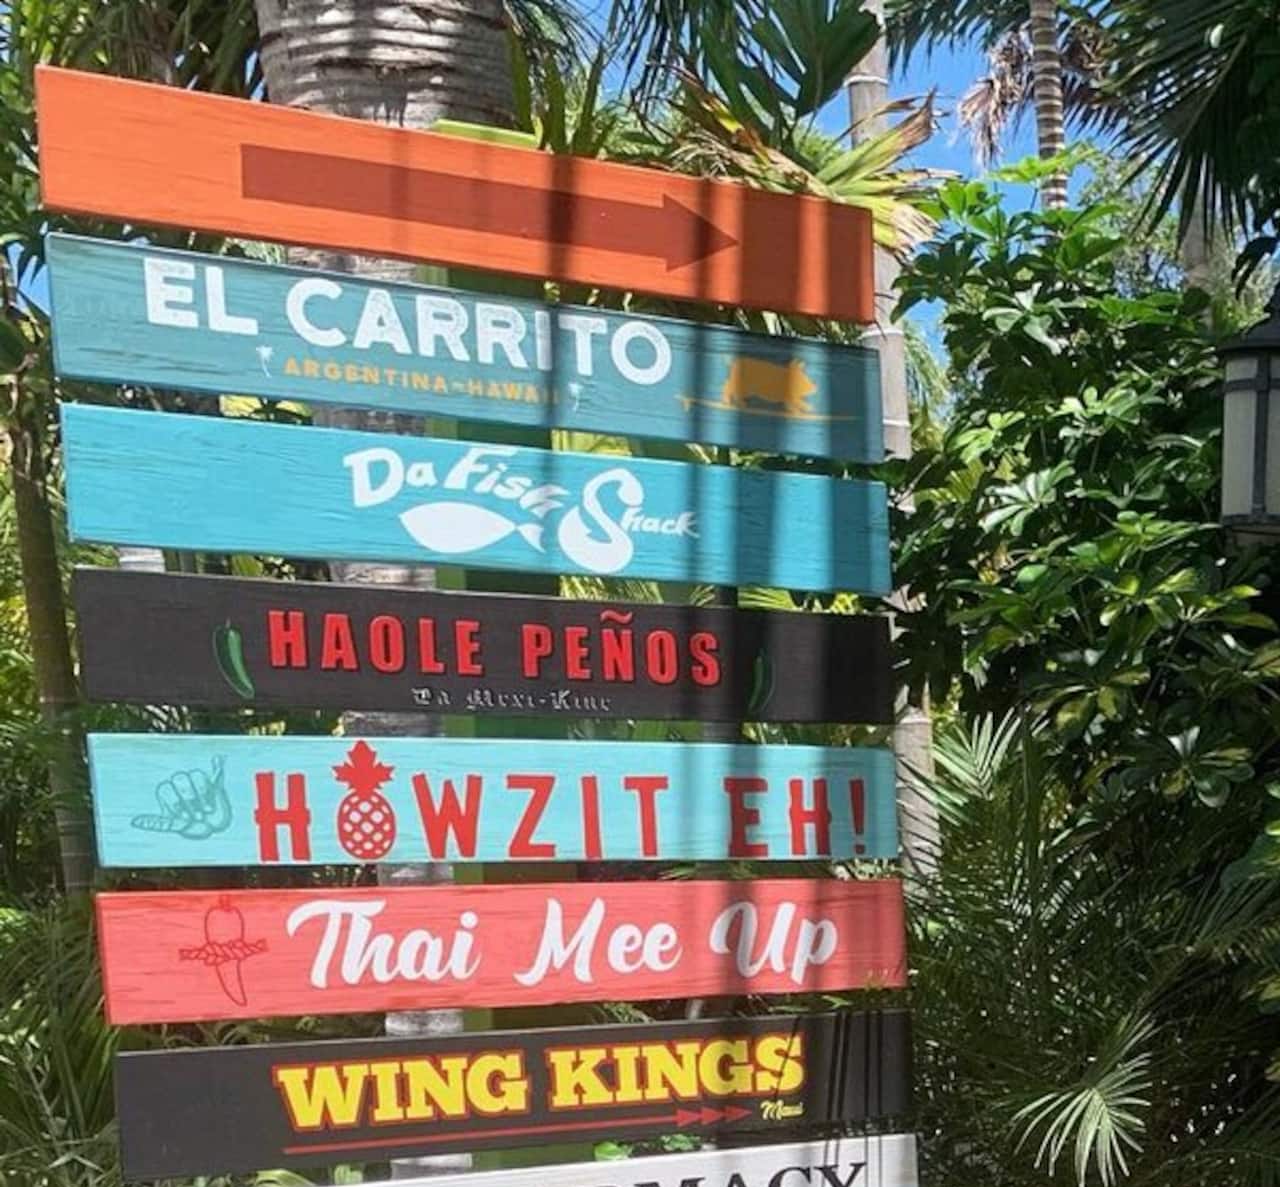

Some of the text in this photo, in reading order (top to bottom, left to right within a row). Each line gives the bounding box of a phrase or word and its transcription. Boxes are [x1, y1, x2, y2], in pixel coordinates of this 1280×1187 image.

[143, 258, 673, 386] EL CARRITO
[343, 446, 701, 574] Da Fish Shack
[267, 608, 724, 687] HAOLE PEÑOS
[723, 775, 870, 858] EH!
[286, 898, 839, 989] Thai Mee Up
[274, 1033, 806, 1133] WING KINGS
